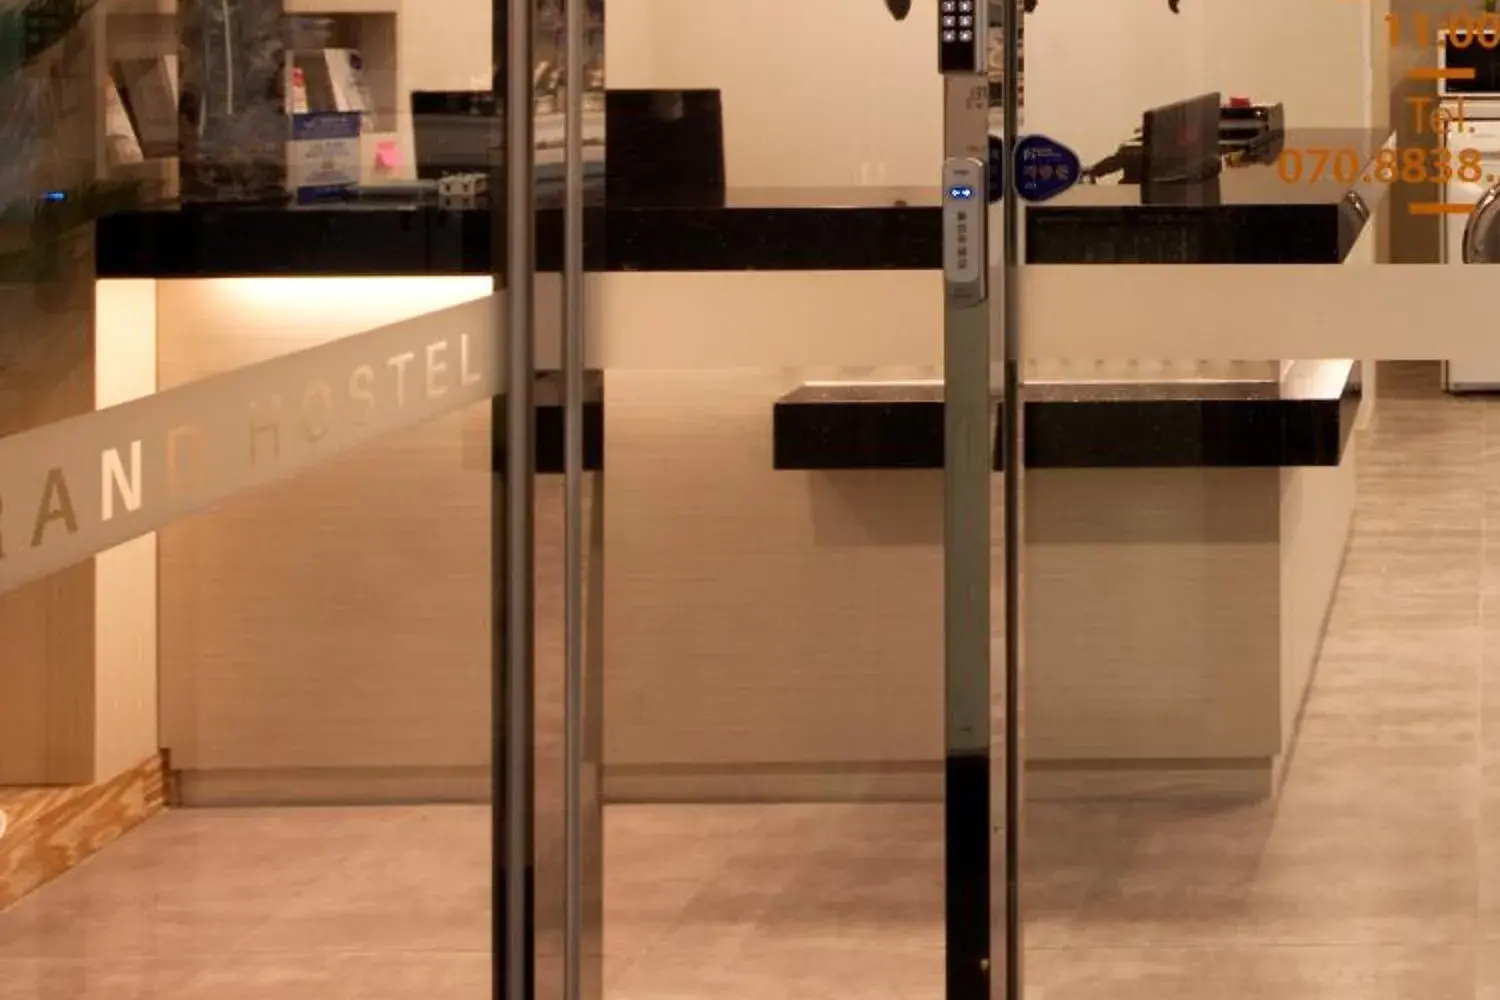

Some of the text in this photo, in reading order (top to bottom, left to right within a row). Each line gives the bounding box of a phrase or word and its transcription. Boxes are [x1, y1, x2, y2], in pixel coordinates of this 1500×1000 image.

[1405, 96, 1476, 135] Tel.
[0, 332, 482, 561] AND HOSTEL
